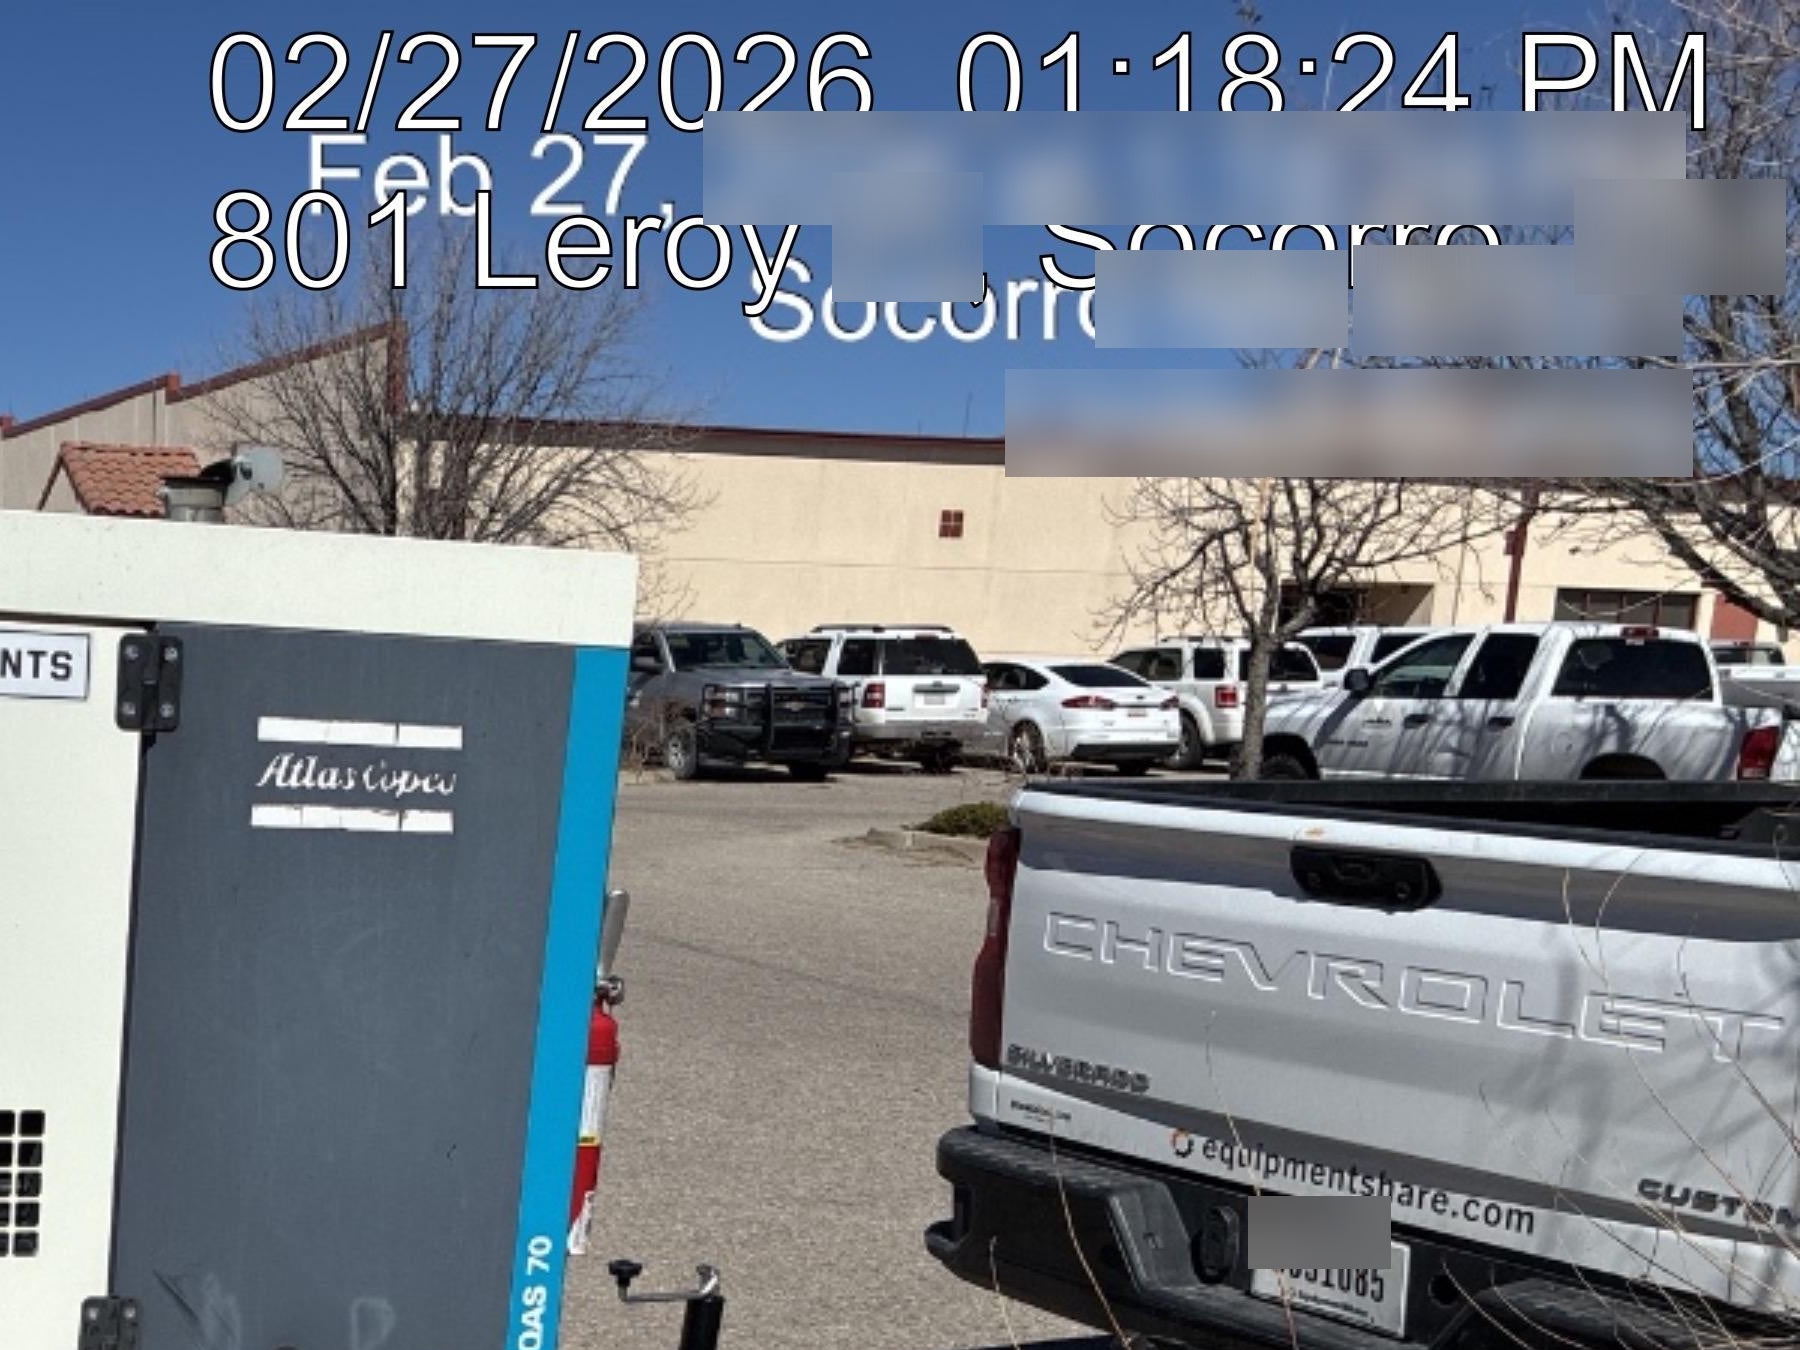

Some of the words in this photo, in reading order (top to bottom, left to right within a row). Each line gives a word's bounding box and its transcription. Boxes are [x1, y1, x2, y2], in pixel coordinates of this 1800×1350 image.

[256, 752, 356, 790] Atlas
[1043, 911, 1785, 1063] CHEVROLET
[1007, 1043, 1150, 1093] SILVERADO
[1201, 1135, 1535, 1236] equipmentshare.com
[525, 1235, 553, 1277] 70
